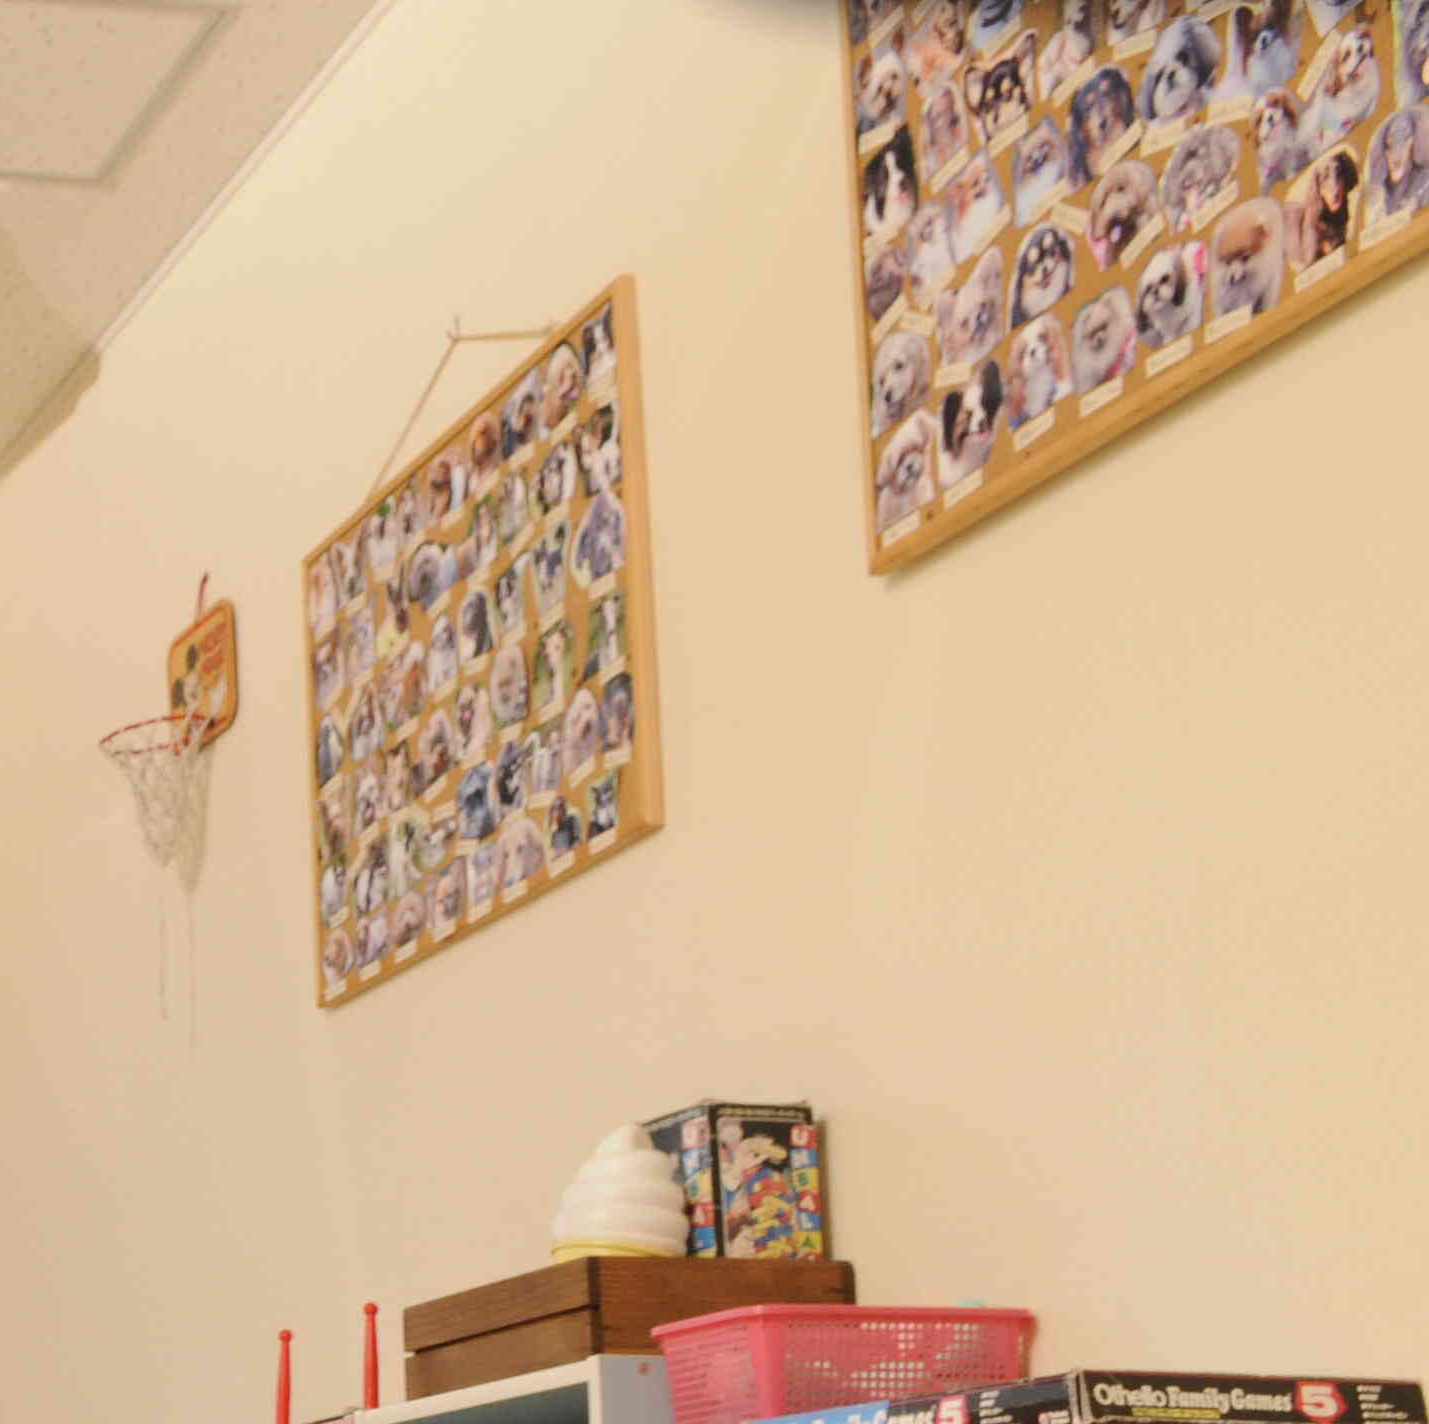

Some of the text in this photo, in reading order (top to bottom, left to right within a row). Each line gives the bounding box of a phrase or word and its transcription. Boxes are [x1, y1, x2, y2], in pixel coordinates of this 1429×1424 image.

[1093, 1383, 1166, 1407] Othello
[1167, 1387, 1230, 1414] Family
[1231, 1388, 1291, 1412] Games
[1299, 1384, 1337, 1418] 5
